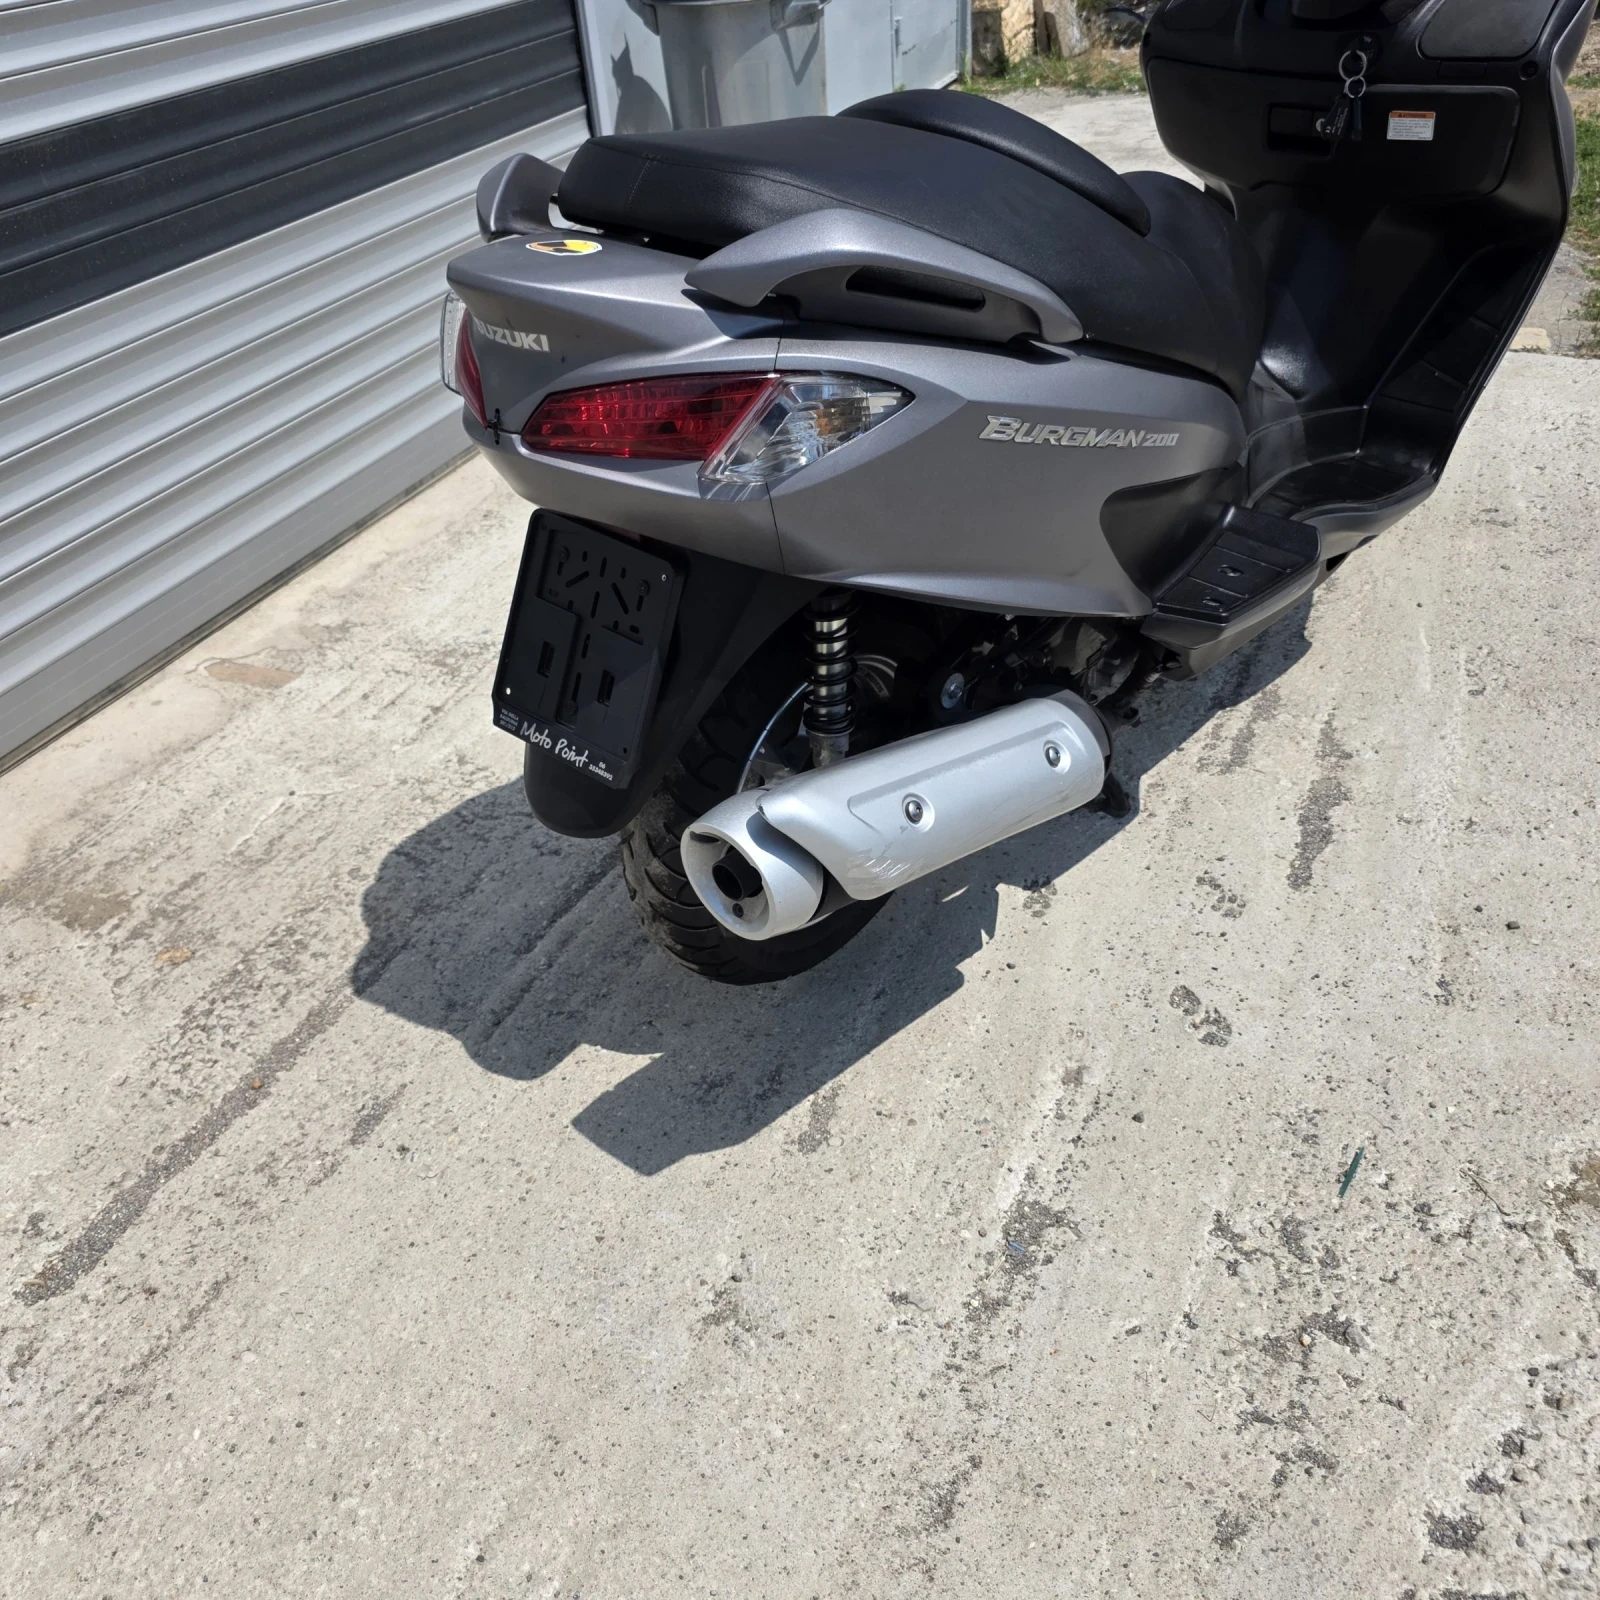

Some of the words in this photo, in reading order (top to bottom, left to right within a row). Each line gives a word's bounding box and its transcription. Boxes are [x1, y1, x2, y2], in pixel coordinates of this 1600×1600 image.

[473, 317, 550, 352] SUZUKI
[979, 415, 1145, 448] BURGMAN
[1142, 432, 1180, 447] 200
[520, 721, 552, 749] Moto
[555, 738, 588, 767] Point
[598, 761, 606, 769] 06
